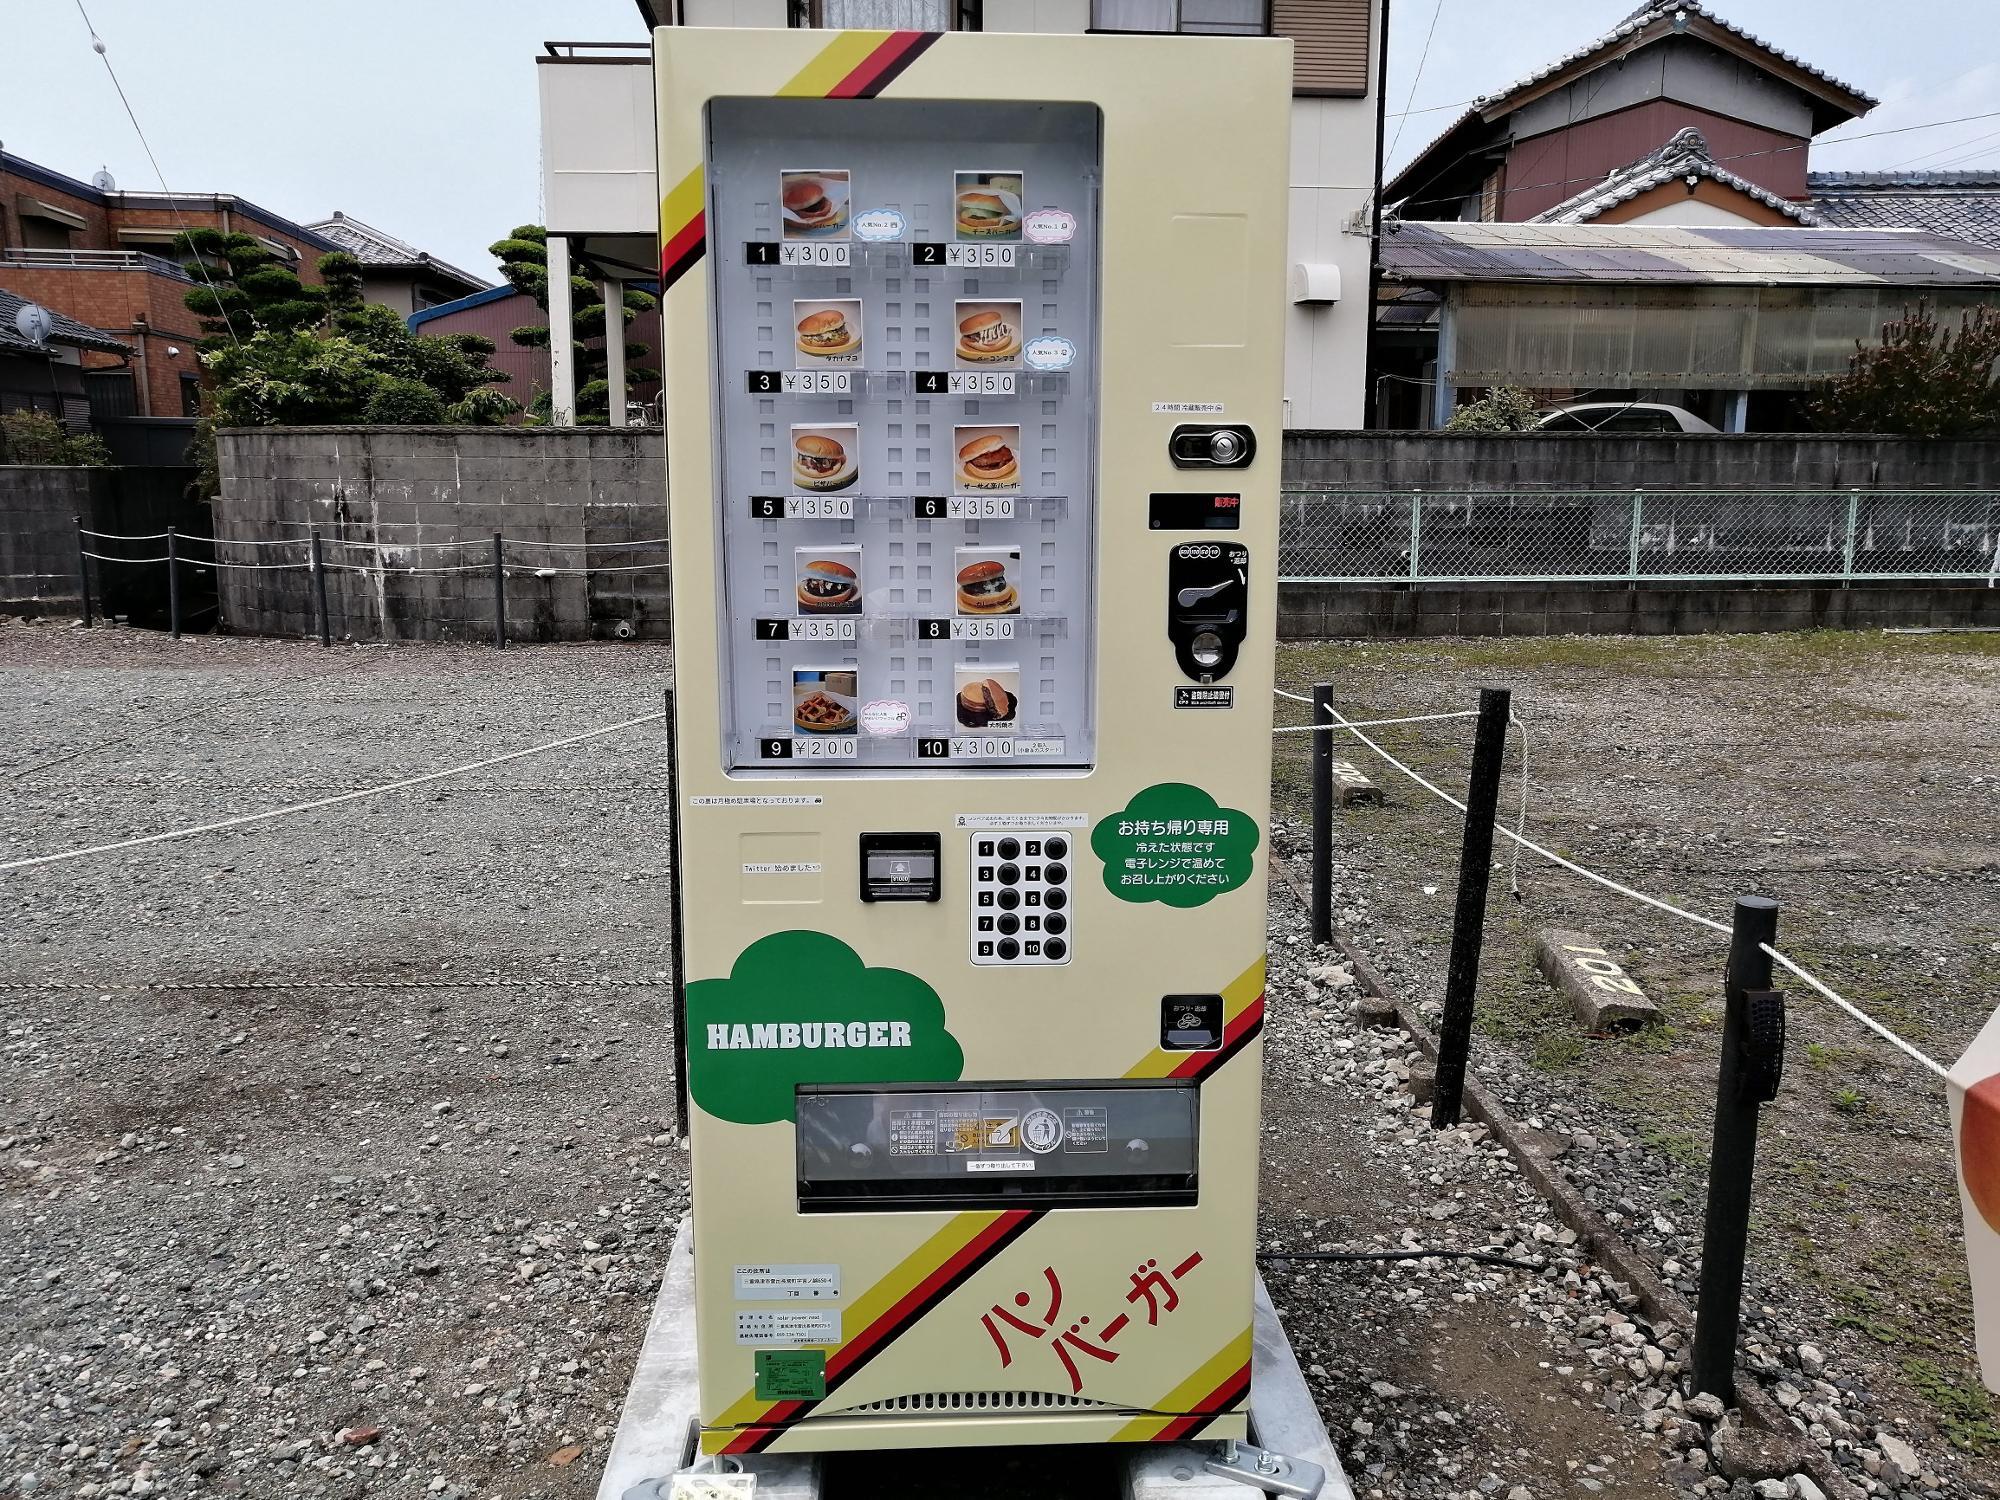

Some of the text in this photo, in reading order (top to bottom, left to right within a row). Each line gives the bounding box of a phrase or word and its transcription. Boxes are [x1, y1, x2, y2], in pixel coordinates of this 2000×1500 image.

[758, 246, 846, 262] 1 ¥300
[924, 246, 1012, 263] 2 ¥350
[759, 374, 847, 390] 3 ¥350
[926, 375, 1012, 391] 4 ¥350
[763, 500, 850, 515] 5 ¥350
[925, 500, 1011, 515] 6 ¥350
[1214, 496, 1240, 508] 販売中
[1228, 550, 1248, 558] おつり
[768, 622, 852, 637] 7 ¥350
[929, 622, 1012, 637] 8 ¥350
[771, 741, 854, 756] 9 ¥200
[924, 741, 1011, 756] 10 ¥300
[1118, 819, 1229, 836] お持ち帰り専用
[1029, 844, 1037, 854] 2
[1136, 842, 1216, 853] 冷えた状態です
[1124, 857, 1226, 869] 電子レンジで温めて
[1029, 869, 1037, 879] 4
[1120, 873, 1230, 885] お召し上がりください
[1030, 894, 1037, 904] 6
[1029, 919, 1036, 929] 8
[1027, 944, 1039, 953] 10
[706, 1021, 912, 1050] HAMBURGER
